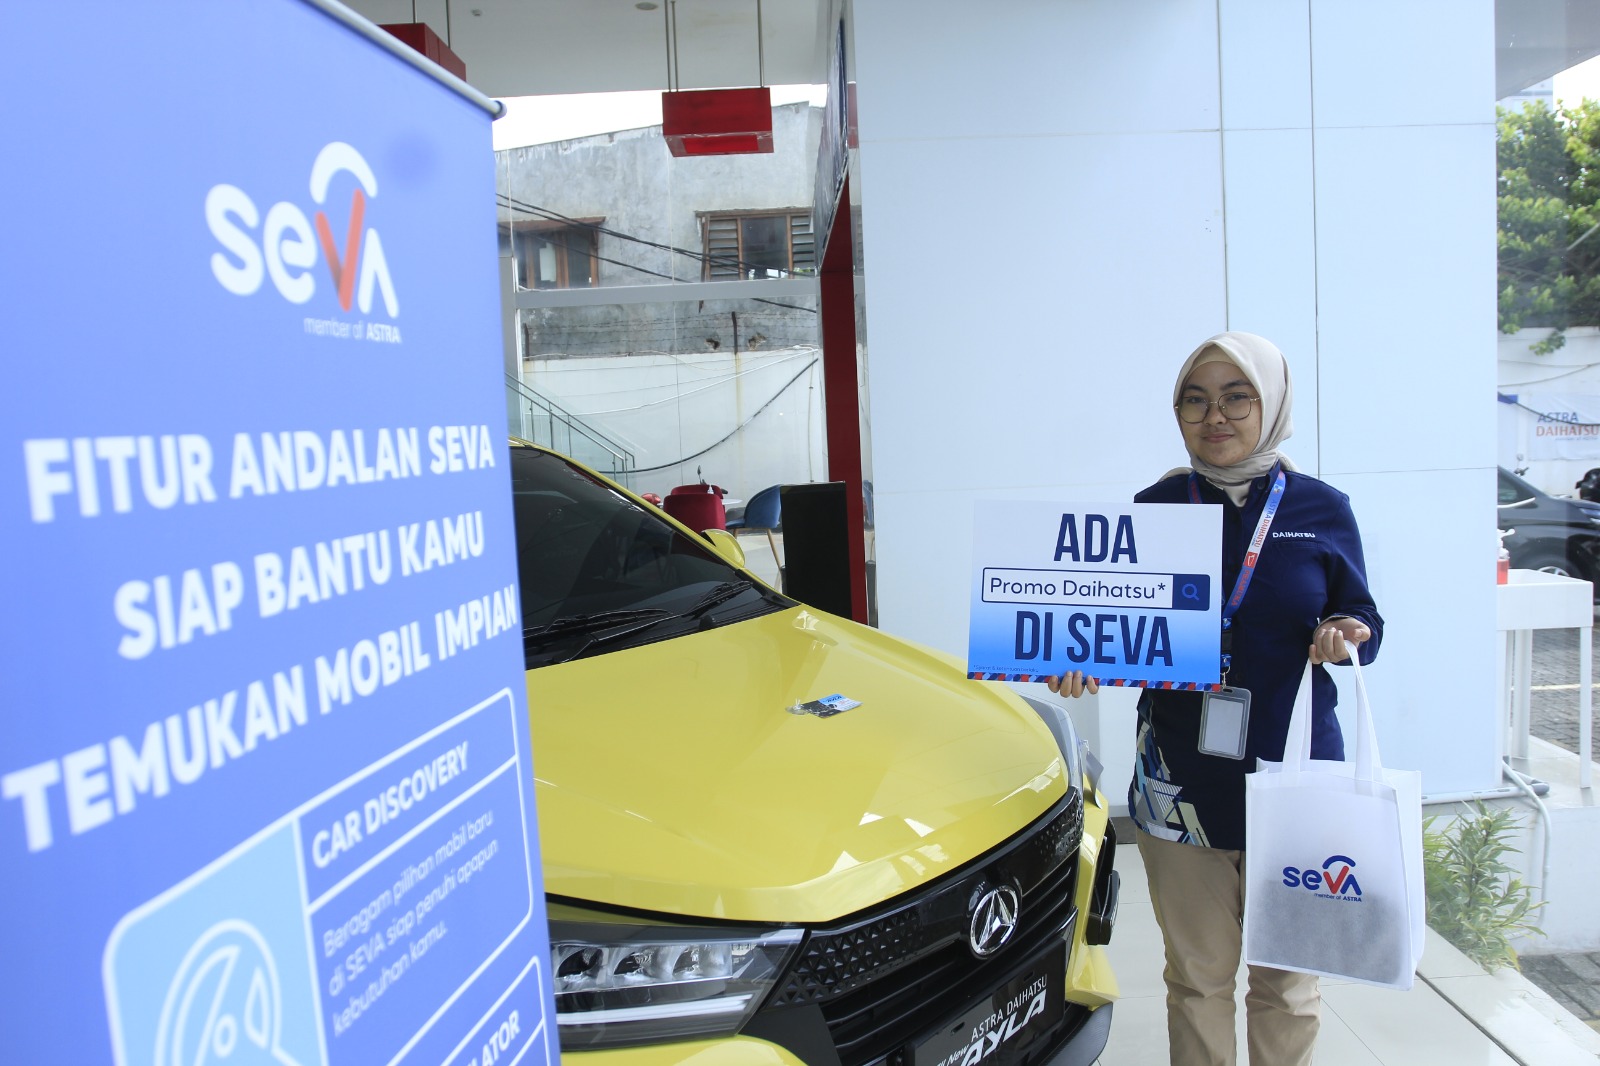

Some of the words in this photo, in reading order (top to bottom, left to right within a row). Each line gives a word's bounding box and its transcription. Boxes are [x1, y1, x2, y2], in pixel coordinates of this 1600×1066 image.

[366, 322, 402, 343] ASTRA
[1536, 425, 1599, 437] DAIHATSU
[1537, 411, 1579, 423] ASTRA
[23, 433, 217, 523] FITUR
[229, 427, 422, 498] ANDALAN
[429, 425, 495, 475] SEVA
[1054, 513, 1138, 563] ADA
[1254, 519, 1270, 547] DAIHATSU
[1265, 500, 1277, 519] ASTRA
[114, 561, 244, 660] SIAP
[254, 530, 391, 618] BANTU
[398, 511, 484, 576] KAMU
[990, 577, 1056, 595] Promo
[1014, 611, 1053, 661] DI
[1066, 612, 1173, 667] SEVA
[2, 664, 308, 852] TEMUKAN
[315, 622, 430, 714] MOBIL
[434, 583, 517, 661] IMPIAN
[312, 810, 363, 869] CAR
[363, 740, 469, 835] DISCOVERY
[323, 889, 392, 958] Beragam
[393, 855, 436, 906] pilihan
[435, 825, 467, 865] mobil
[467, 809, 494, 840] baru
[329, 963, 345, 997] di
[346, 931, 387, 982] SEVA
[386, 910, 415, 945] siap
[416, 869, 457, 925] penuhi
[457, 839, 498, 883] apapun
[333, 953, 410, 1037] kebutuhan
[409, 920, 448, 964] kamu.
[971, 1009, 1003, 1042] ASTRA
[1007, 973, 1047, 1016] DAIHATSU
[961, 989, 1046, 1066] AYLA
